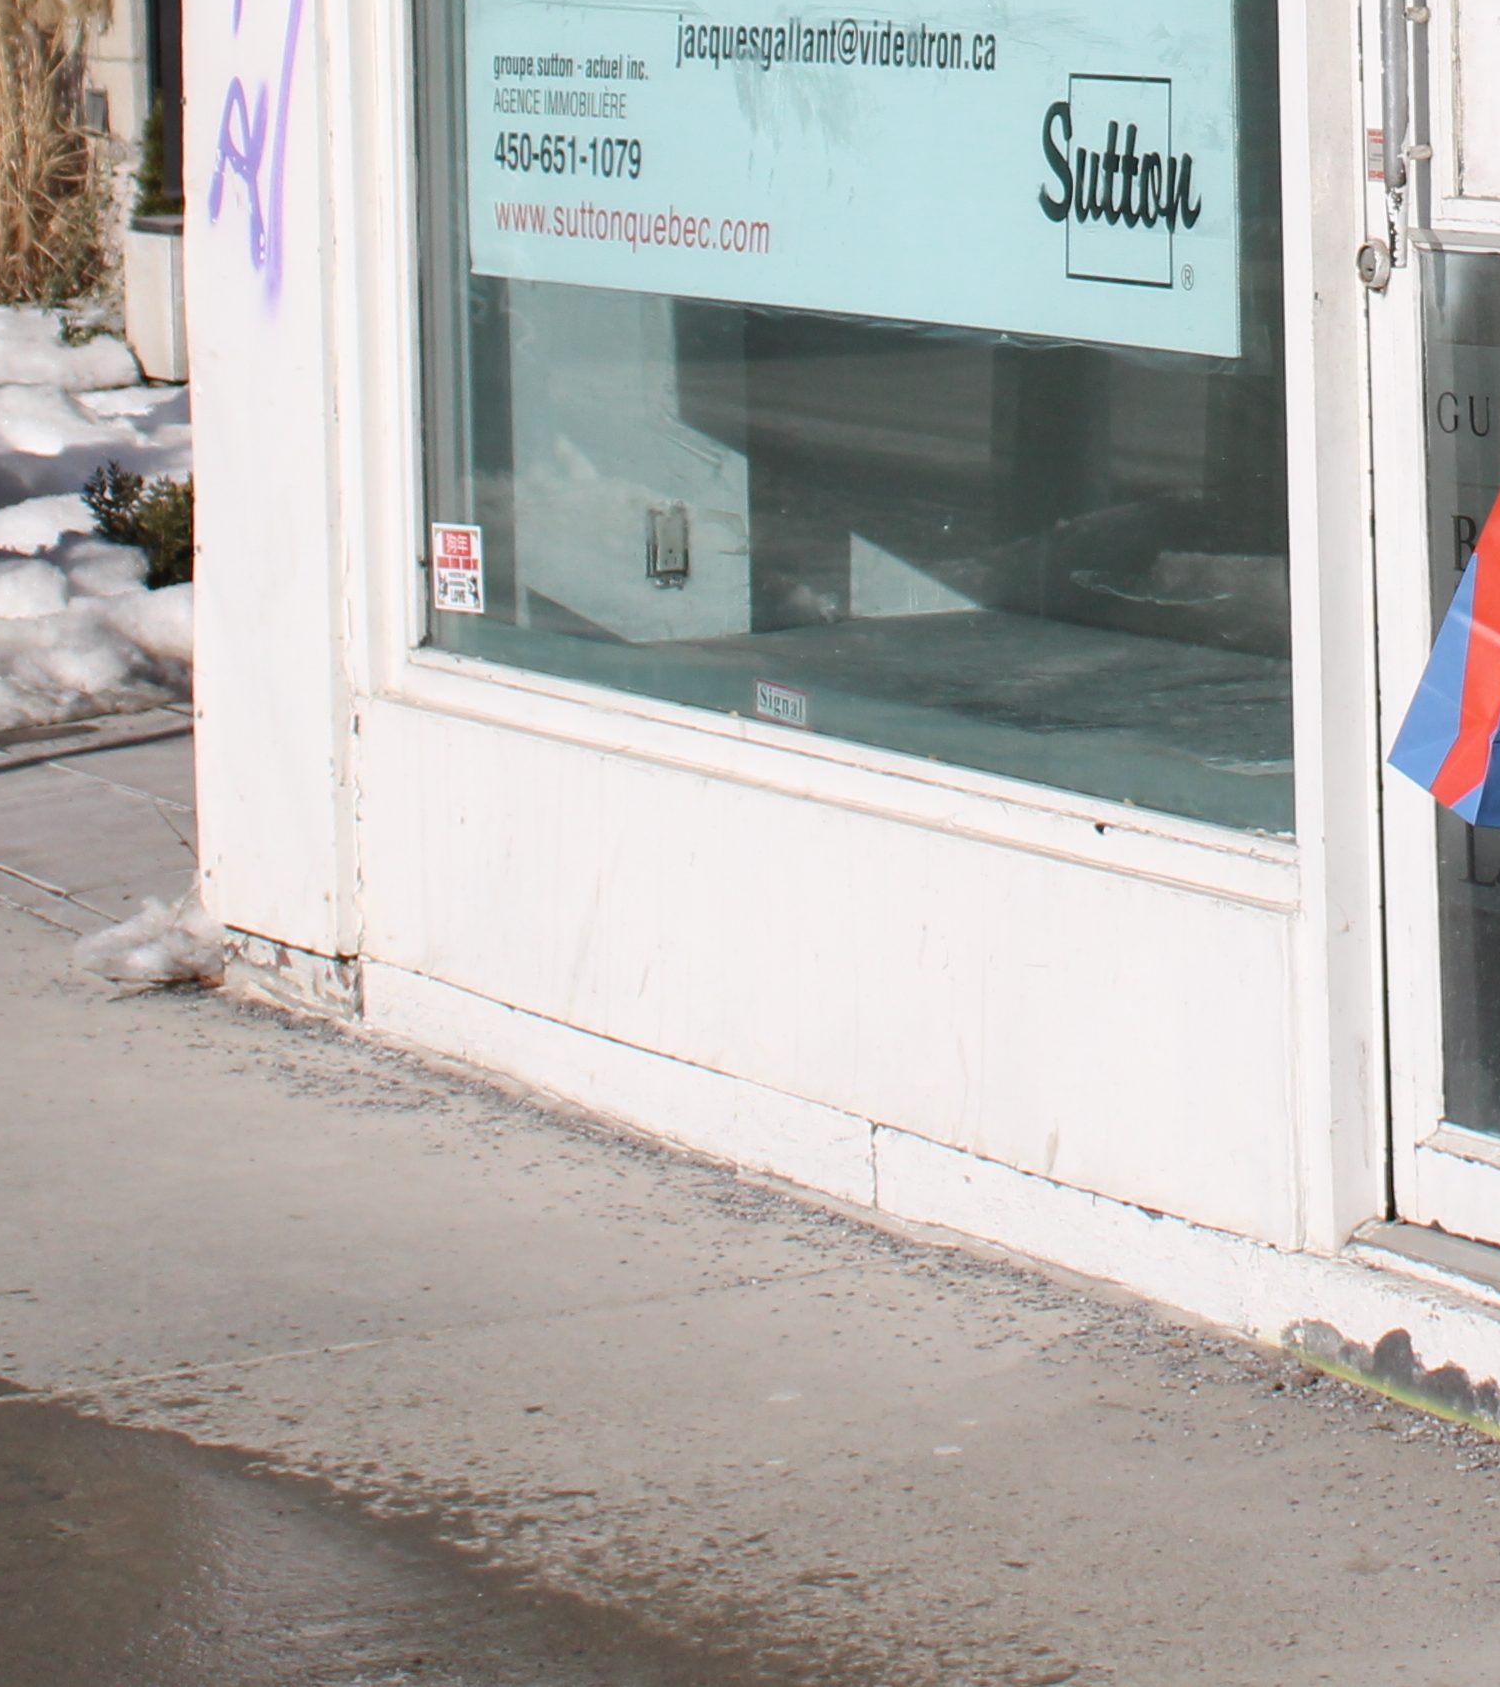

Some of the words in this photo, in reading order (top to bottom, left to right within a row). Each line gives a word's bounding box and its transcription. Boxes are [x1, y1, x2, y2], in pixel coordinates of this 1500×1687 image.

[493, 53, 534, 81] groupe
[537, 53, 573, 78] sutton
[585, 54, 623, 80] actuel
[626, 55, 649, 80] inc.
[675, 12, 997, 73] jacquesgallant@videotron.ca
[493, 87, 541, 115] AGENCE
[543, 86, 627, 120] IMMOBILIÈRE
[494, 130, 642, 180] 450-651-1079
[1036, 100, 1203, 233] Sutton
[493, 200, 772, 255] www.suttonquebec.com
[759, 684, 803, 723] Signal
